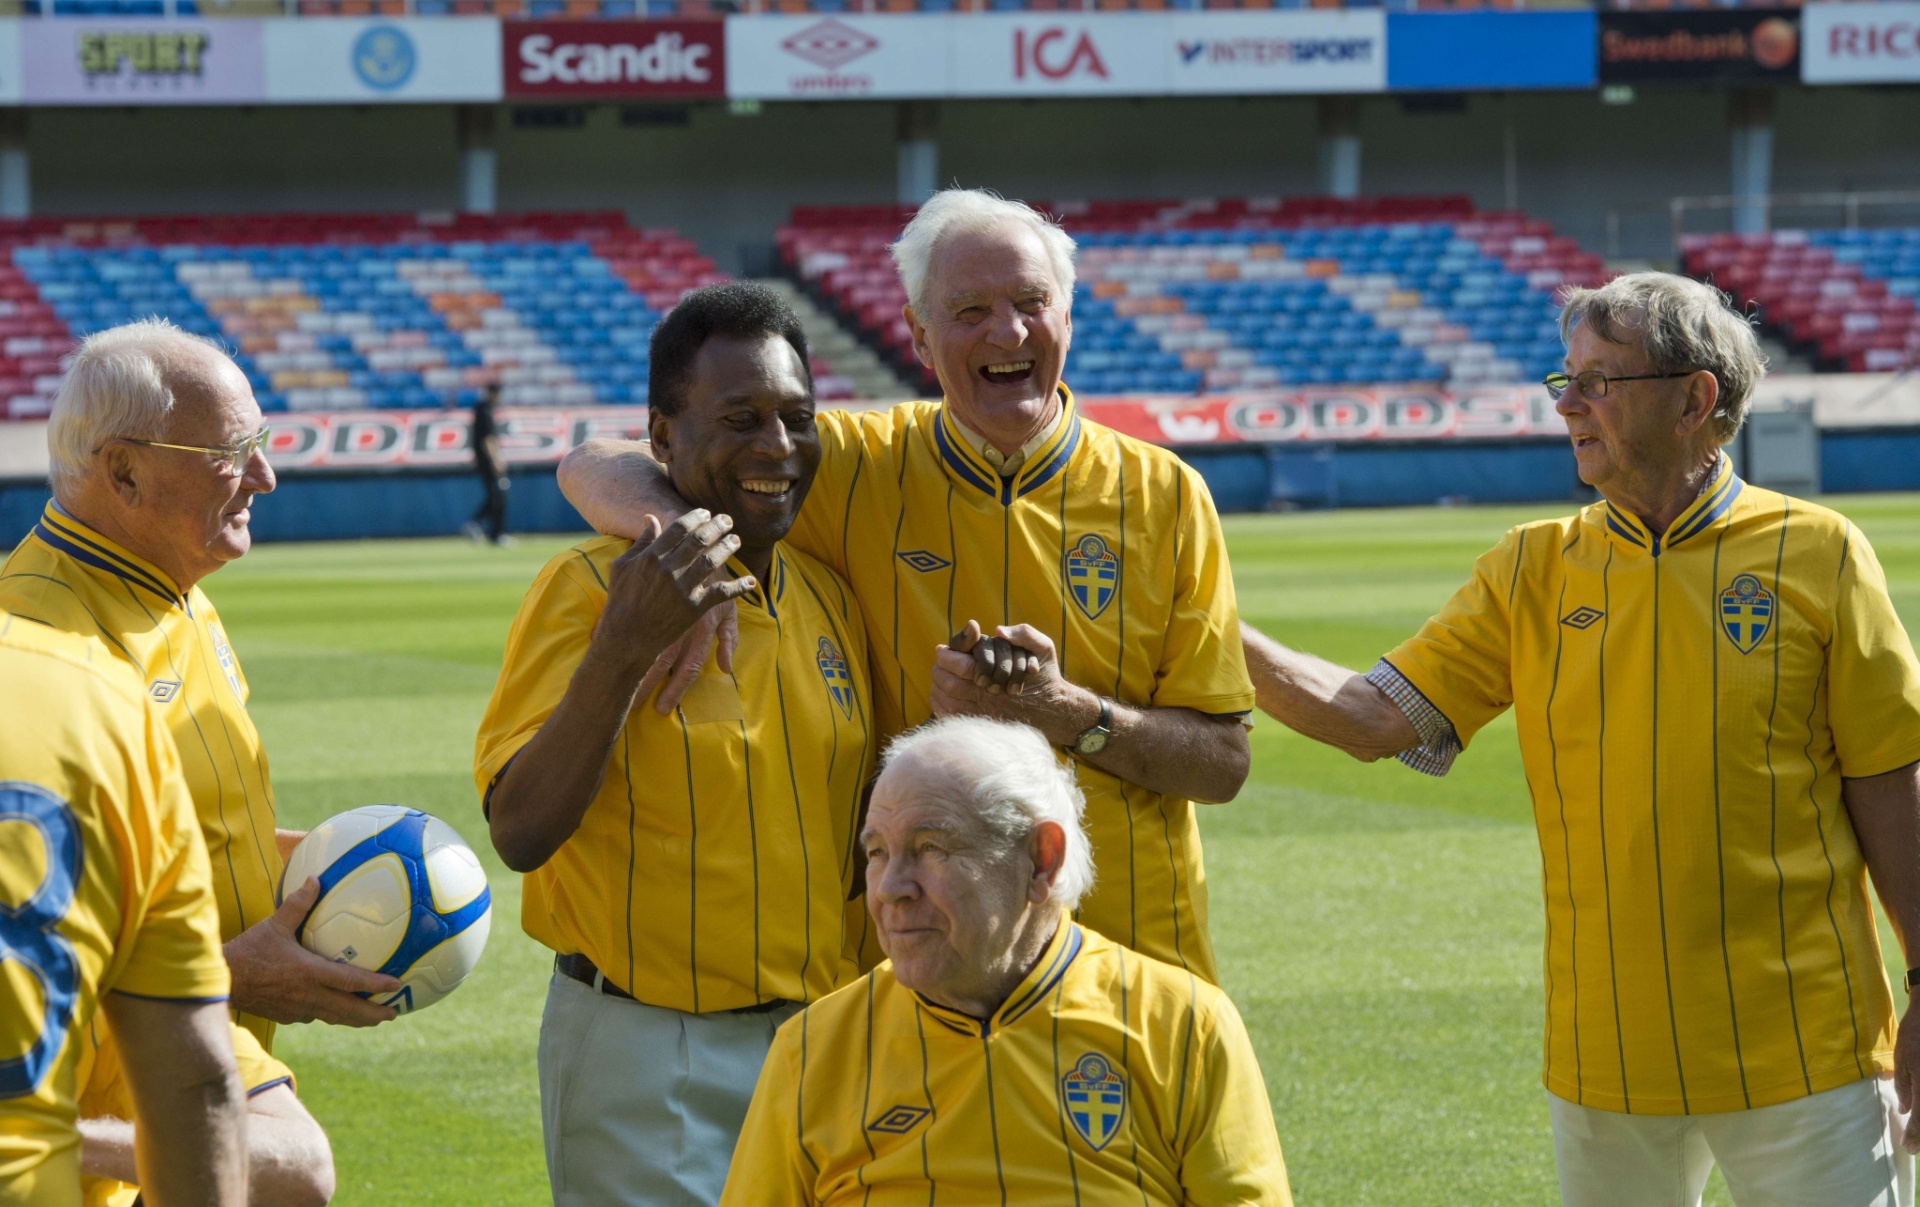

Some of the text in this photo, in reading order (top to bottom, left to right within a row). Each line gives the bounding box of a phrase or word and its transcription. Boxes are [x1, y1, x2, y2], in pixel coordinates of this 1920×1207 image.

[78, 32, 208, 76] SPORT
[519, 33, 711, 84] Scandic
[1013, 27, 1110, 81] ICA
[1208, 38, 1375, 64] INTERSPORT
[1603, 28, 1749, 63] Swedbank
[1827, 21, 1920, 58] RIC
